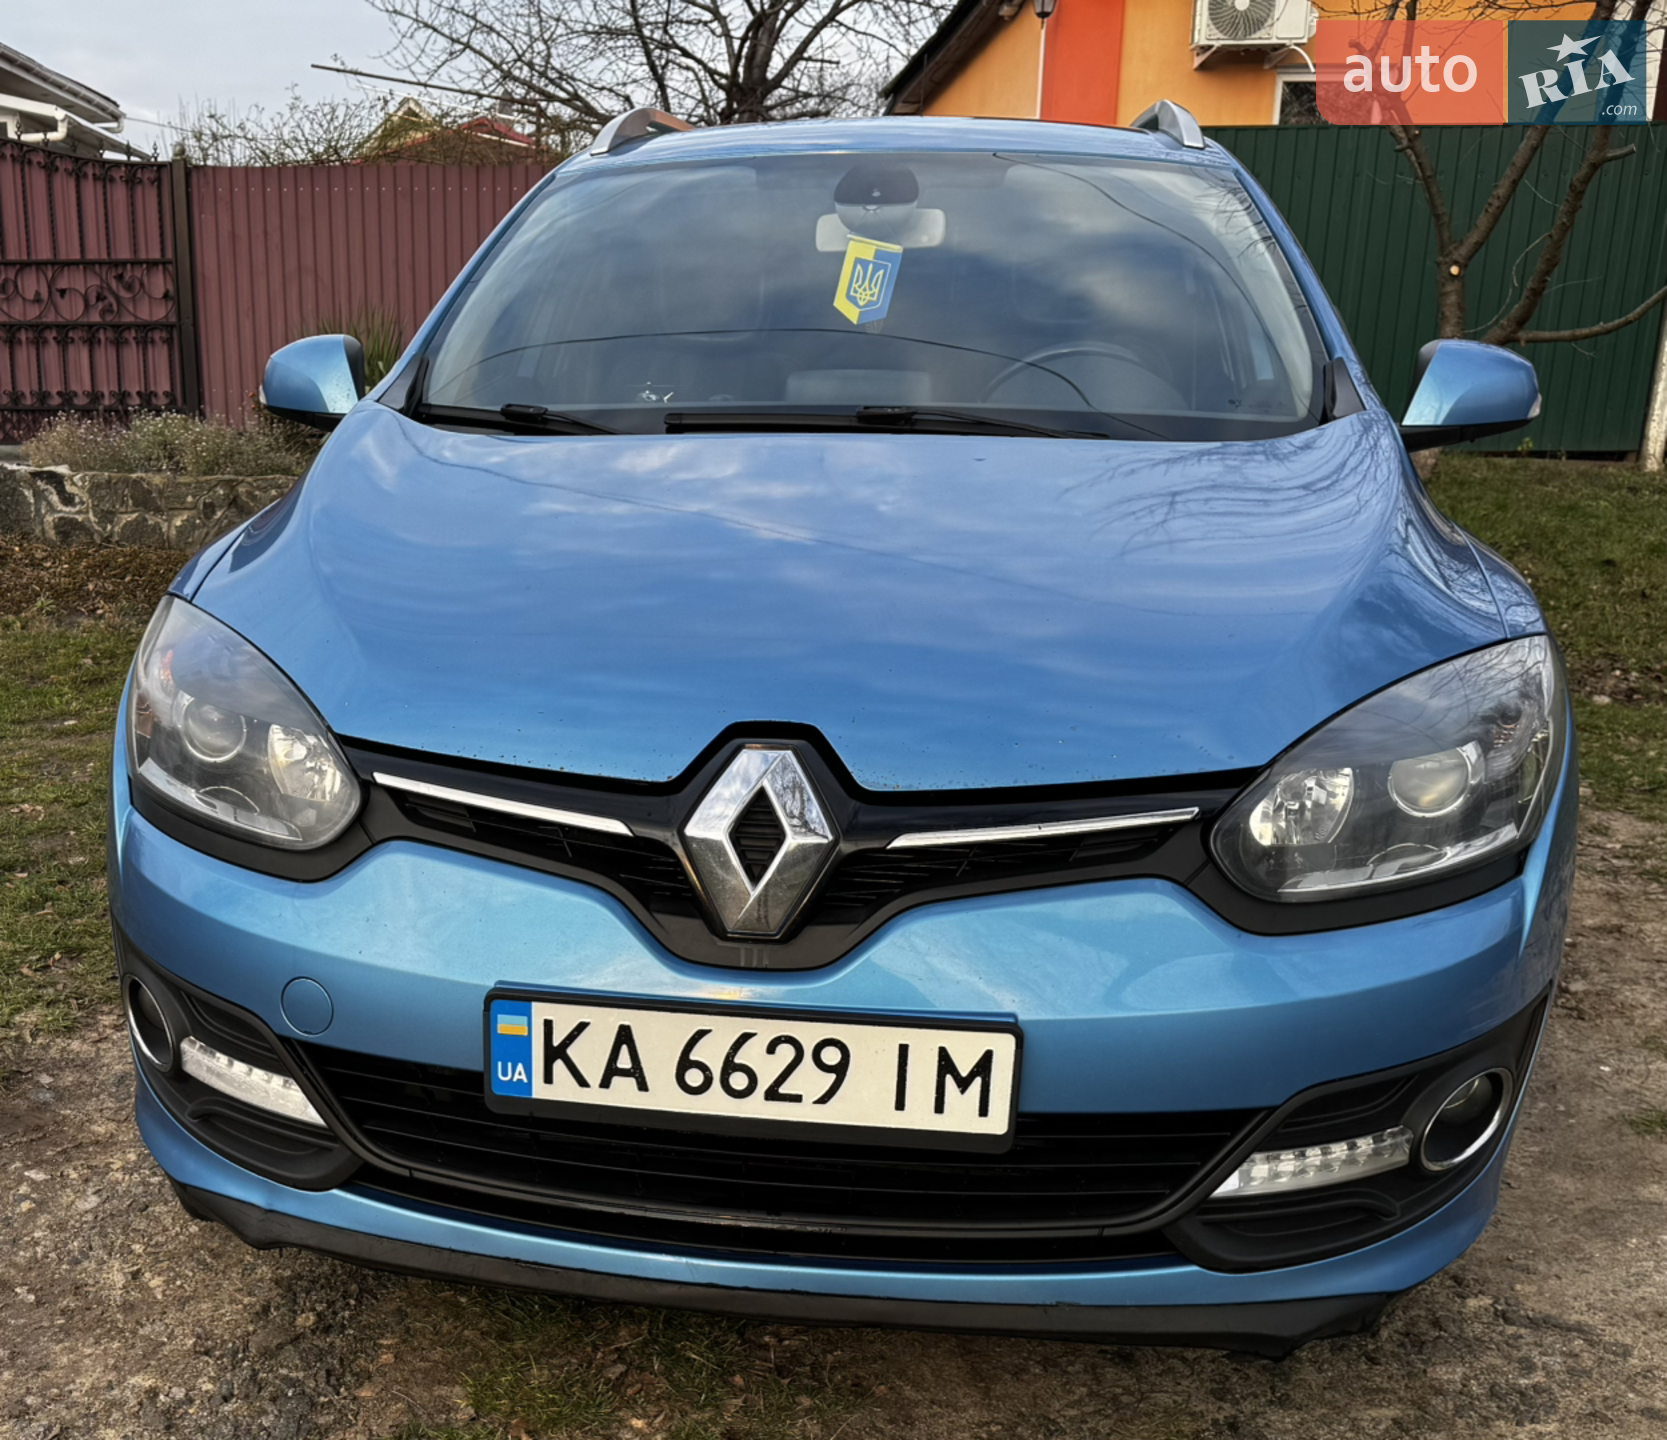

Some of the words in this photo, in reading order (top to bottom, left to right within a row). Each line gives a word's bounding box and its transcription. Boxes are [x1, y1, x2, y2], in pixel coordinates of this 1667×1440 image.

[497, 1061, 528, 1083] UA
[543, 1018, 650, 1093] KA
[675, 1028, 851, 1105] 6629
[894, 1043, 994, 1118] IM
